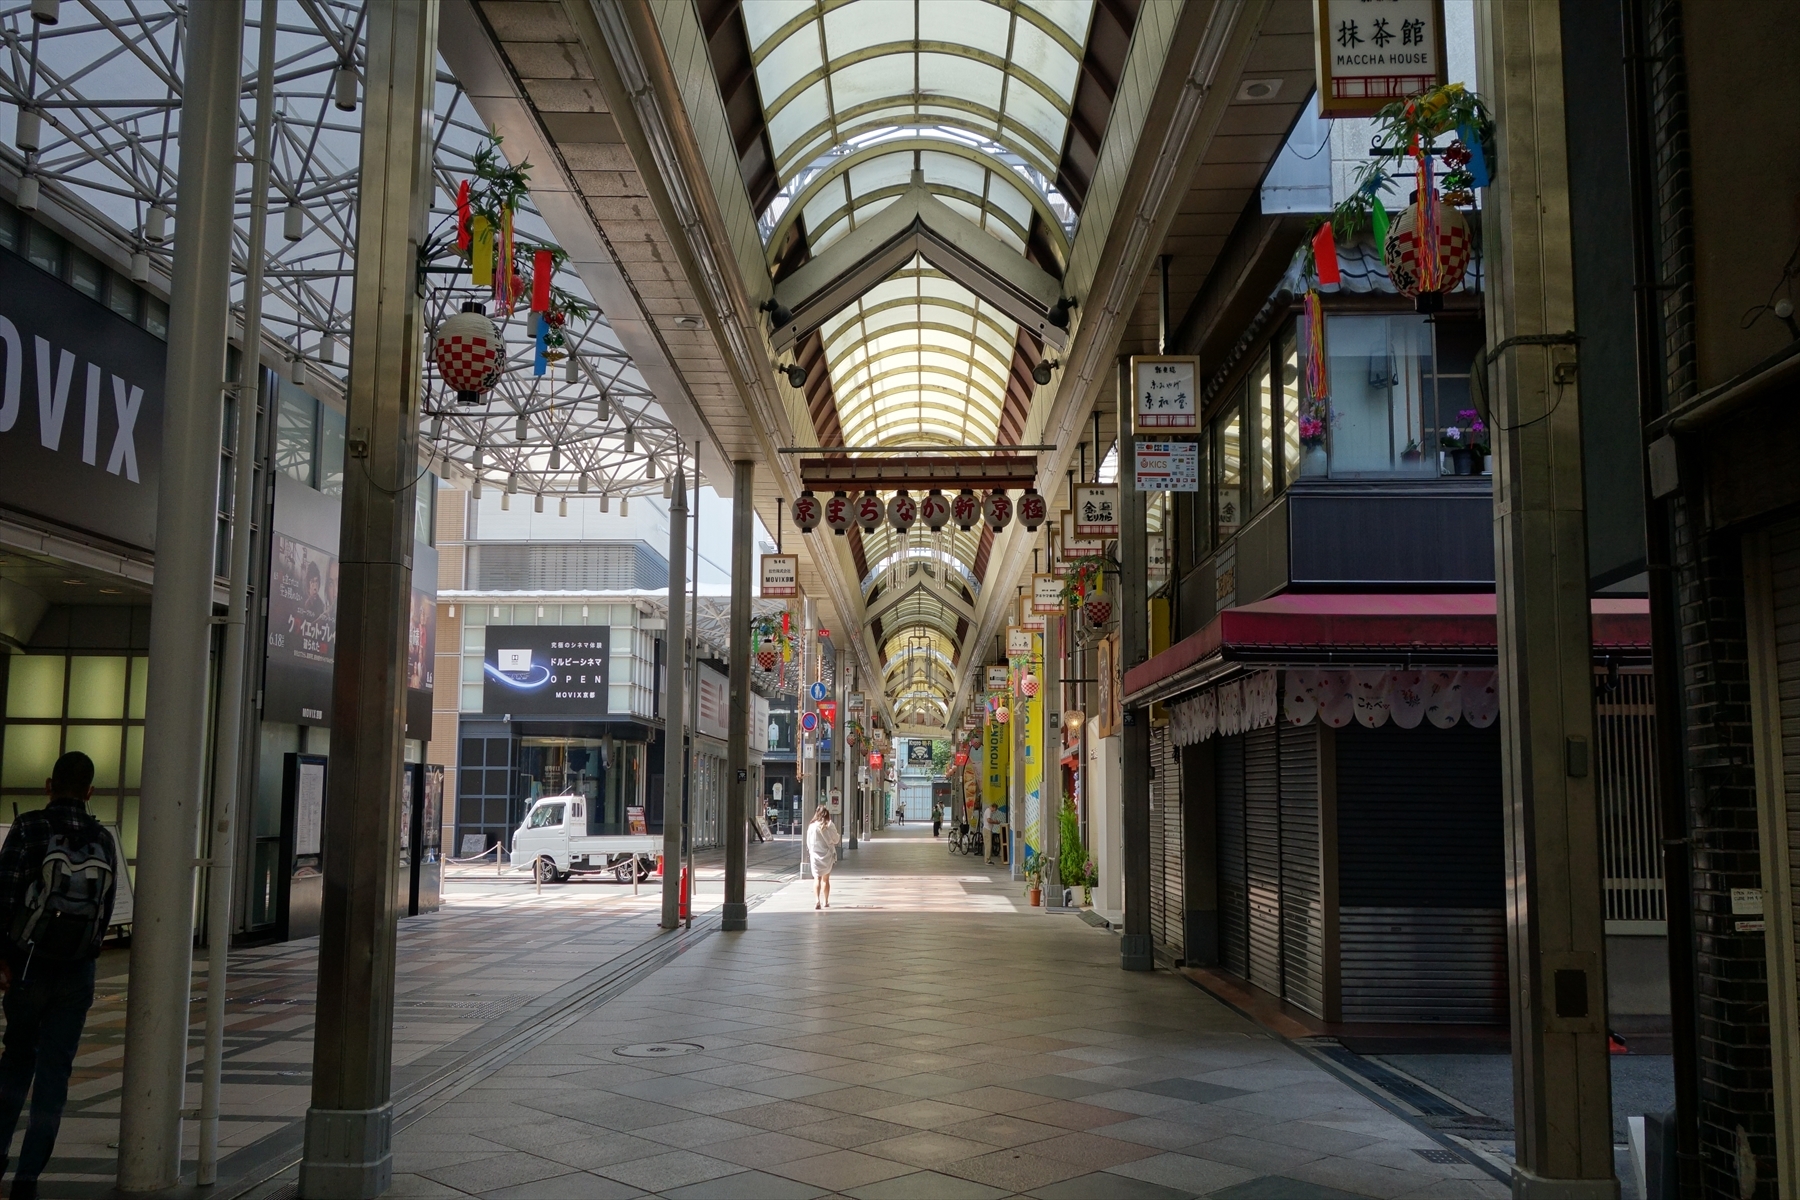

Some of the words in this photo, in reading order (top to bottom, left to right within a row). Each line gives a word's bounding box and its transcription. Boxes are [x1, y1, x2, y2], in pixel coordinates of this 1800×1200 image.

[1337, 17, 1425, 49] 抹茶館
[1337, 54, 1385, 65] MACCHA
[1389, 53, 1428, 64] HOUSE
[1148, 460, 1168, 469] KICS
[550, 658, 602, 666] ドルビーシネマ
[550, 675, 602, 684] OPEN
[555, 691, 596, 699] MOVIX京都
